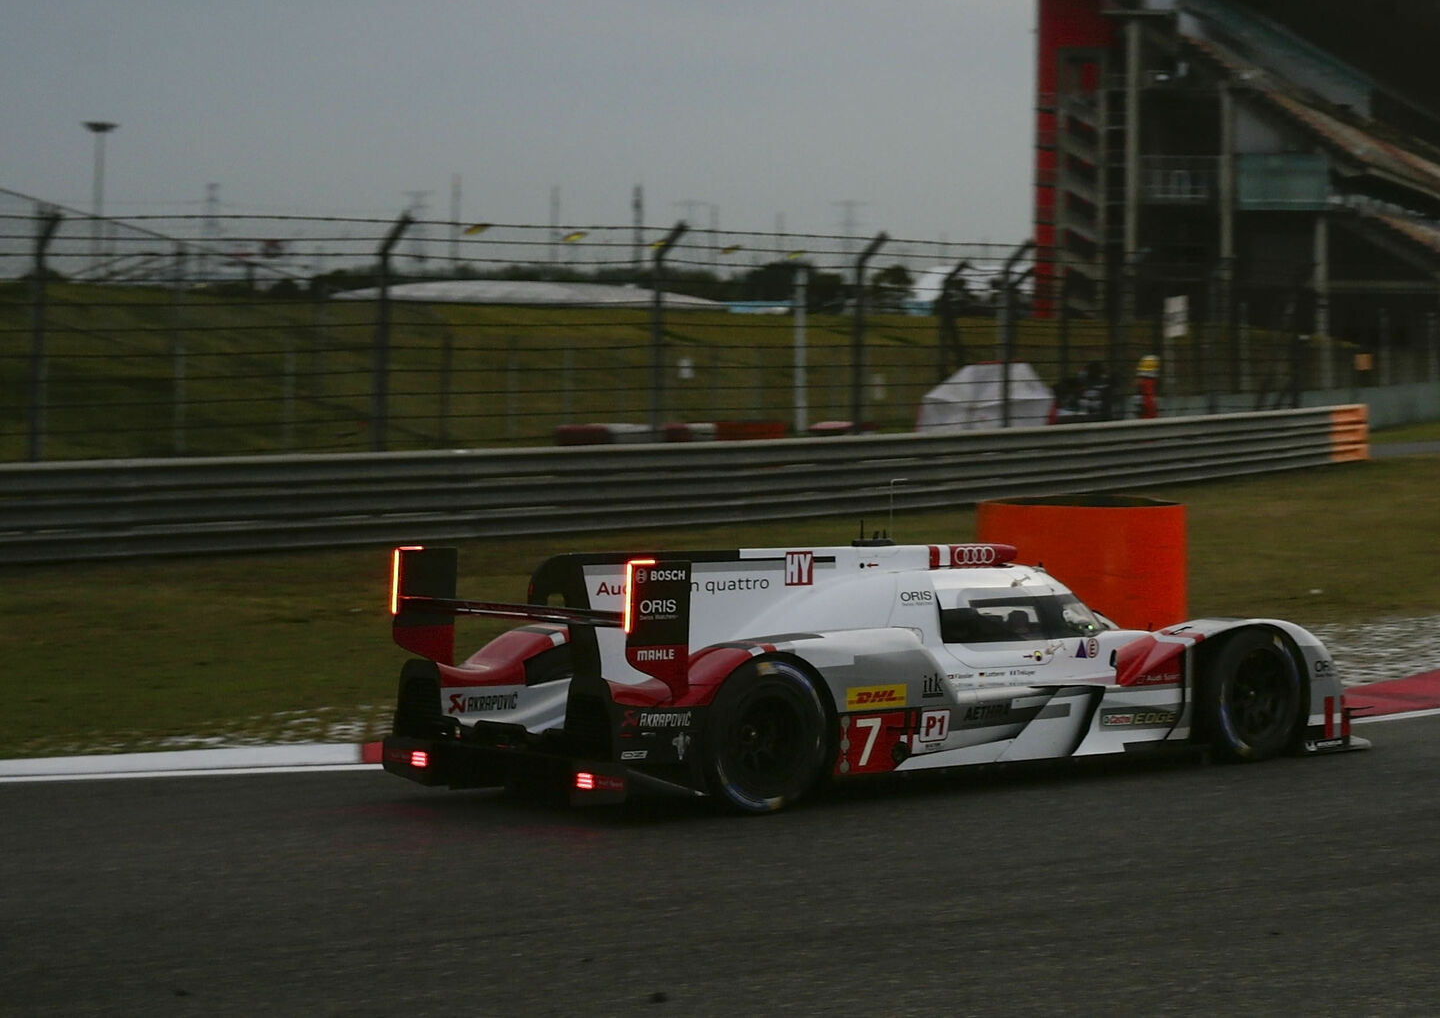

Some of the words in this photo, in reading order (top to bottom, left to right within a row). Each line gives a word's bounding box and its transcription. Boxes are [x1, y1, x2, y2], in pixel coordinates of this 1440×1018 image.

[650, 569, 686, 582] BOSCH
[787, 554, 812, 584] HY
[705, 577, 770, 592] quattro
[900, 590, 932, 602] ORIS
[640, 598, 677, 614] ORIS
[637, 648, 675, 662] MAHLE
[856, 689, 896, 704] DHL
[1133, 710, 1177, 725] EDGE
[925, 714, 945, 737] P1
[855, 717, 882, 767] 7
